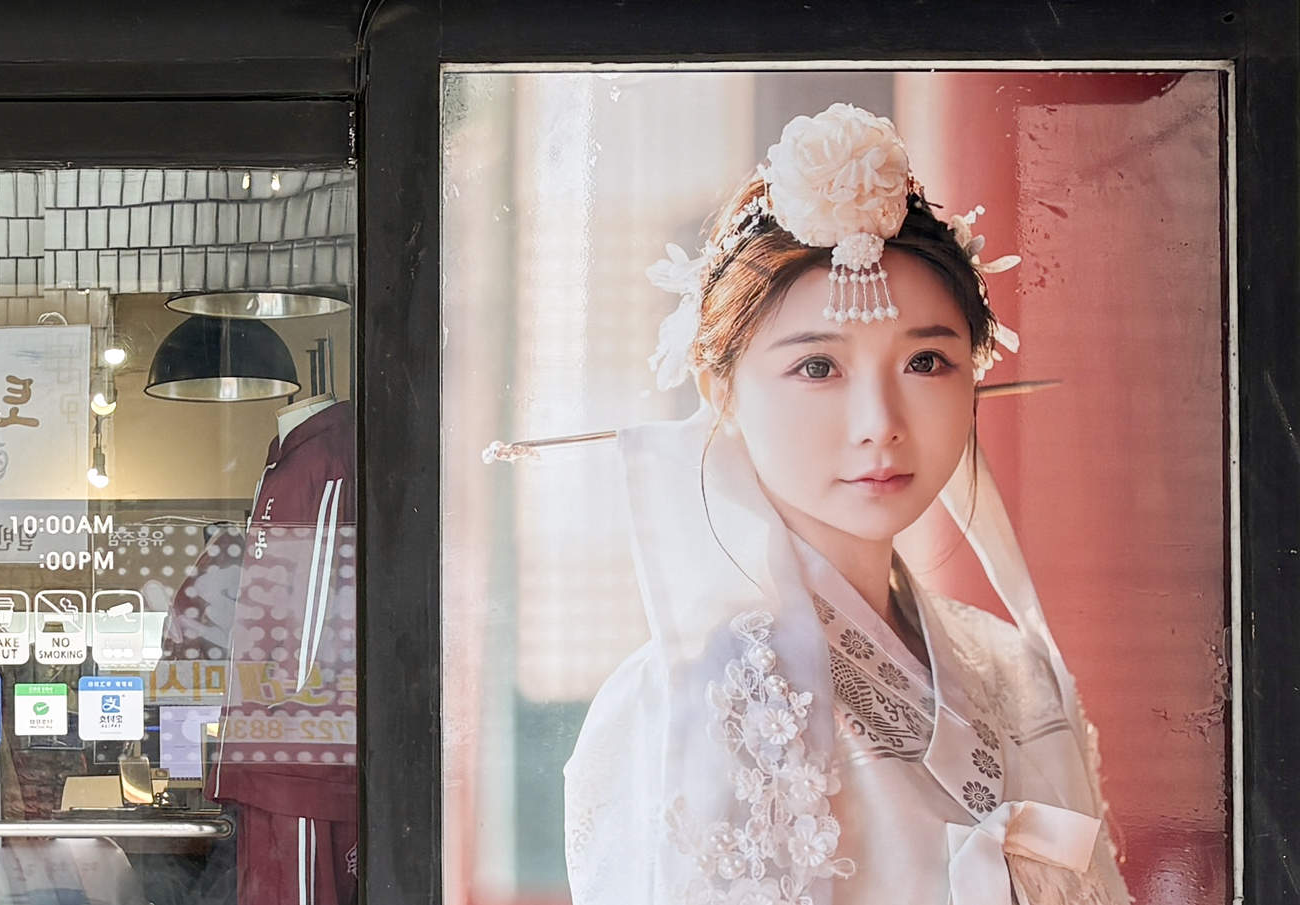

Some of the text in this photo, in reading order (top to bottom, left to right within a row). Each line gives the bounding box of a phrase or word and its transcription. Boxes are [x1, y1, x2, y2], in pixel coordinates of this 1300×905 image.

[9, 514, 115, 535] 10:00AM
[38, 550, 115, 571] :00PM
[51, 637, 70, 648] NO
[38, 649, 84, 660] SMOKING
